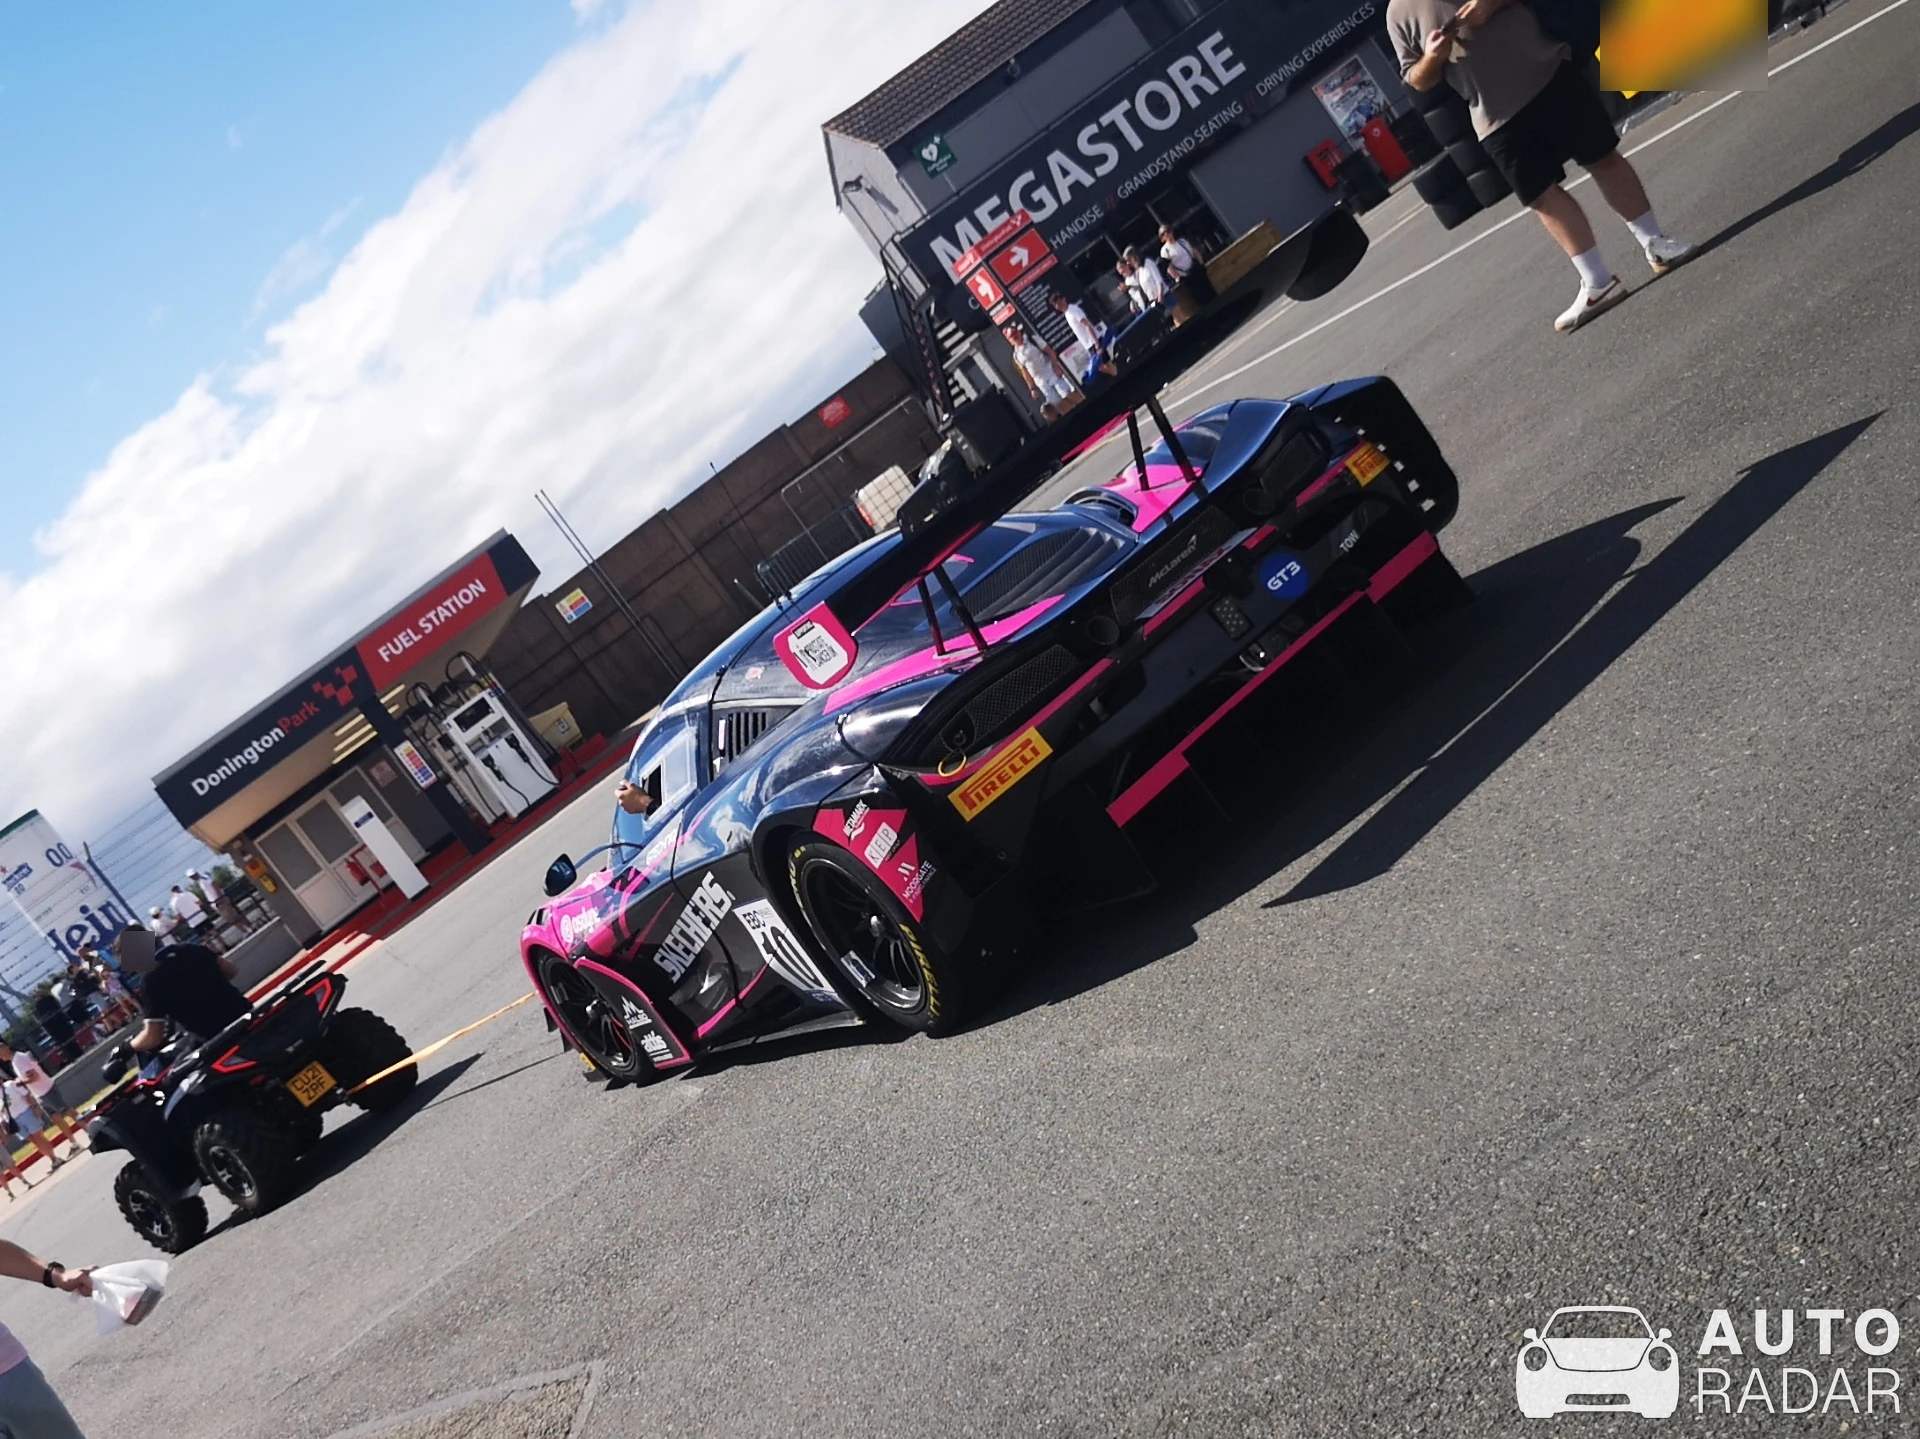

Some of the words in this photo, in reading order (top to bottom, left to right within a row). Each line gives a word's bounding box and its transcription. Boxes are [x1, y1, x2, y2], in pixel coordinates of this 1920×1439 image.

[1050, 204, 1105, 250] HANDISE
[1116, 137, 1196, 200] GRANDSTAND
[1194, 100, 1244, 144] SEATING
[1255, 56, 1305, 98] DRIVING
[1301, 2, 1377, 65] EXPERIENCES
[929, 31, 1247, 286] MEGASTORE
[1149, 543, 1197, 588] McLaren
[1339, 528, 1361, 554] TOW
[1266, 559, 1303, 592] GT3
[377, 629, 423, 664] FUEL
[418, 577, 487, 634] STATION
[958, 737, 1041, 812] PIRELLI
[842, 799, 868, 837] METAMARK
[902, 859, 933, 900] MOORGATE
[652, 870, 733, 984] SKECHERS
[741, 910, 767, 930] EBC
[760, 925, 824, 989] 10
[899, 923, 941, 1019] PIRELLI
